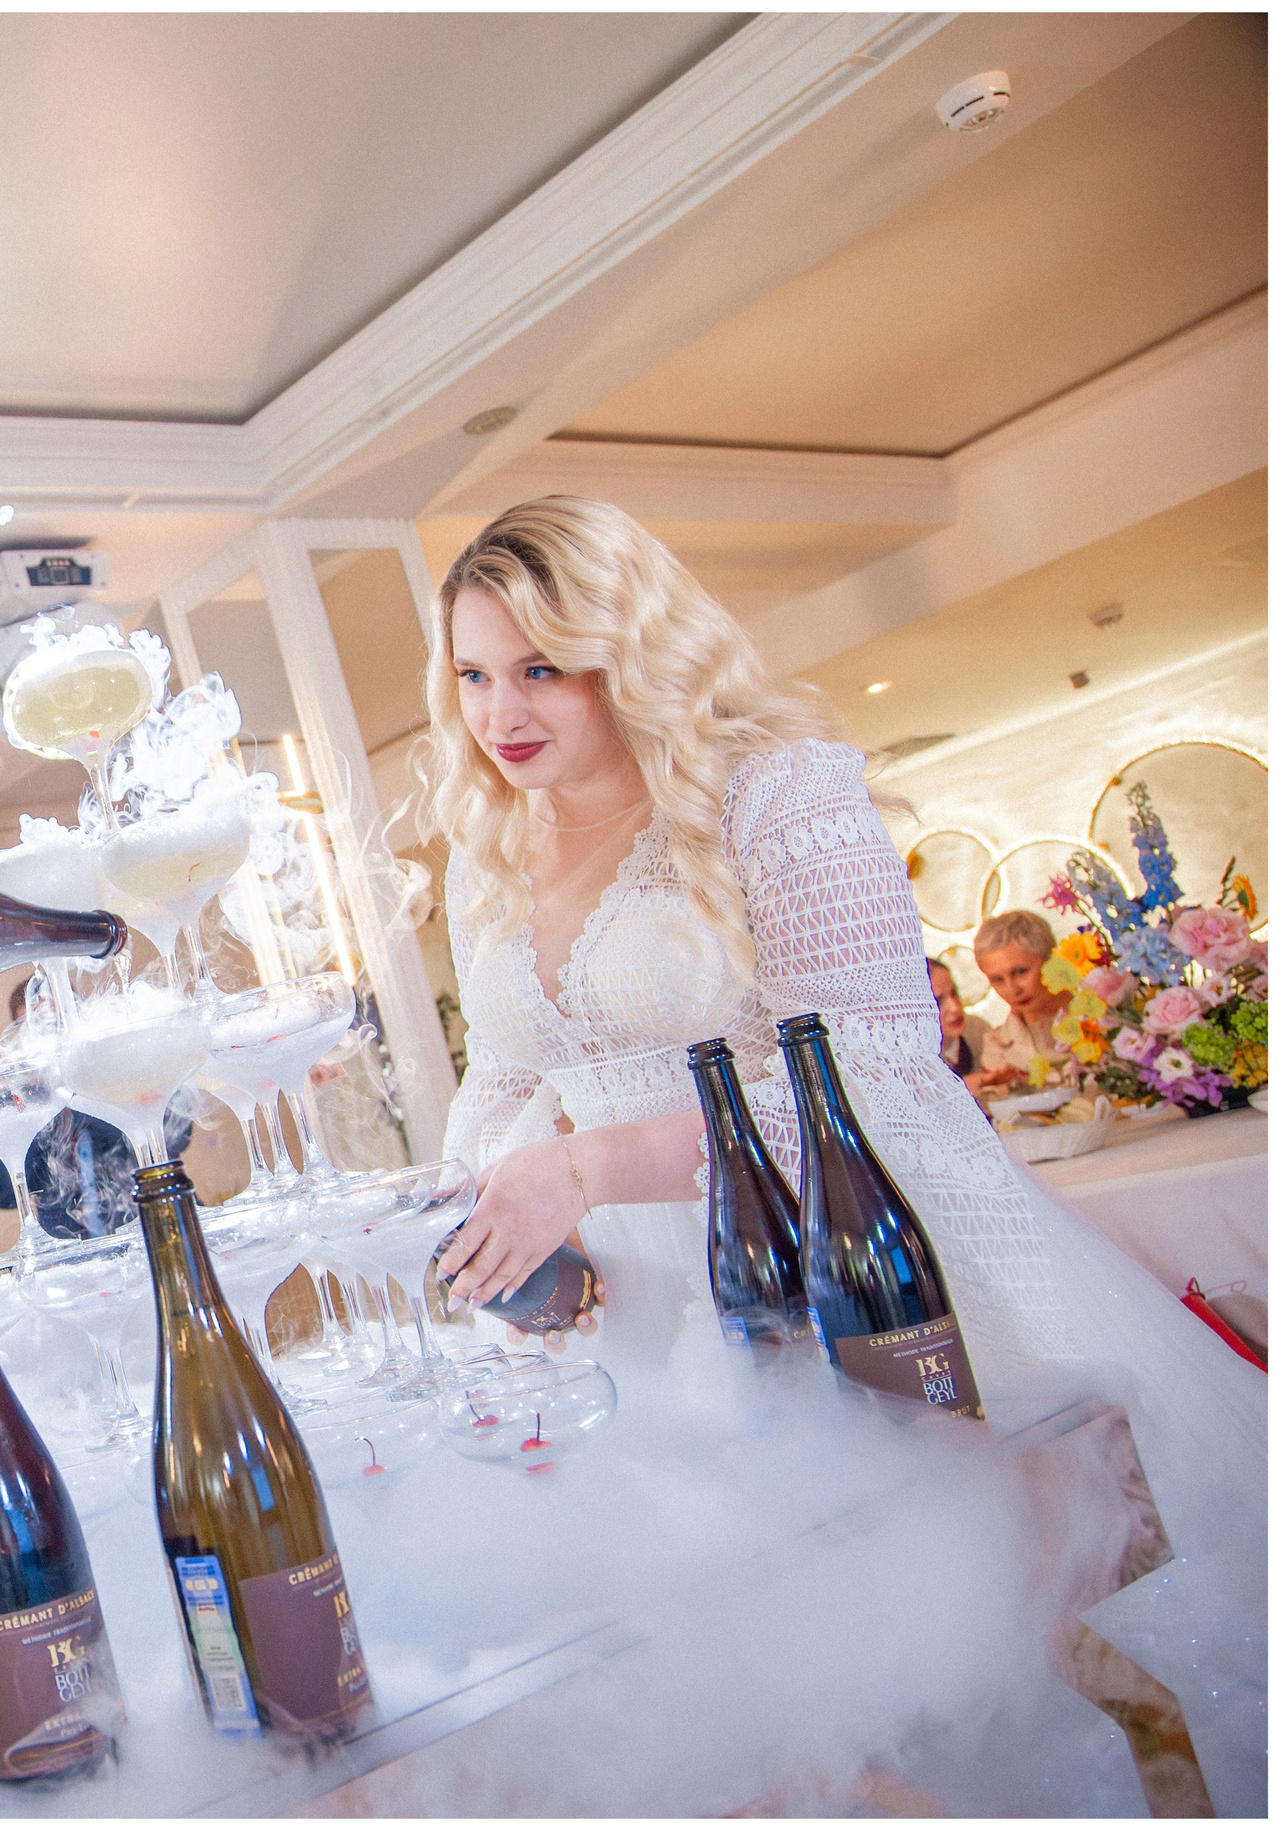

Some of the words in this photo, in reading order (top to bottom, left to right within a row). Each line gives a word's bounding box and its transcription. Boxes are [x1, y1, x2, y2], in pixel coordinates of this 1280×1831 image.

[869, 1330, 919, 1347] CRÉMANT
[923, 1376, 954, 1396] BOTT
[57, 1590, 95, 1616] D'ALSACE
